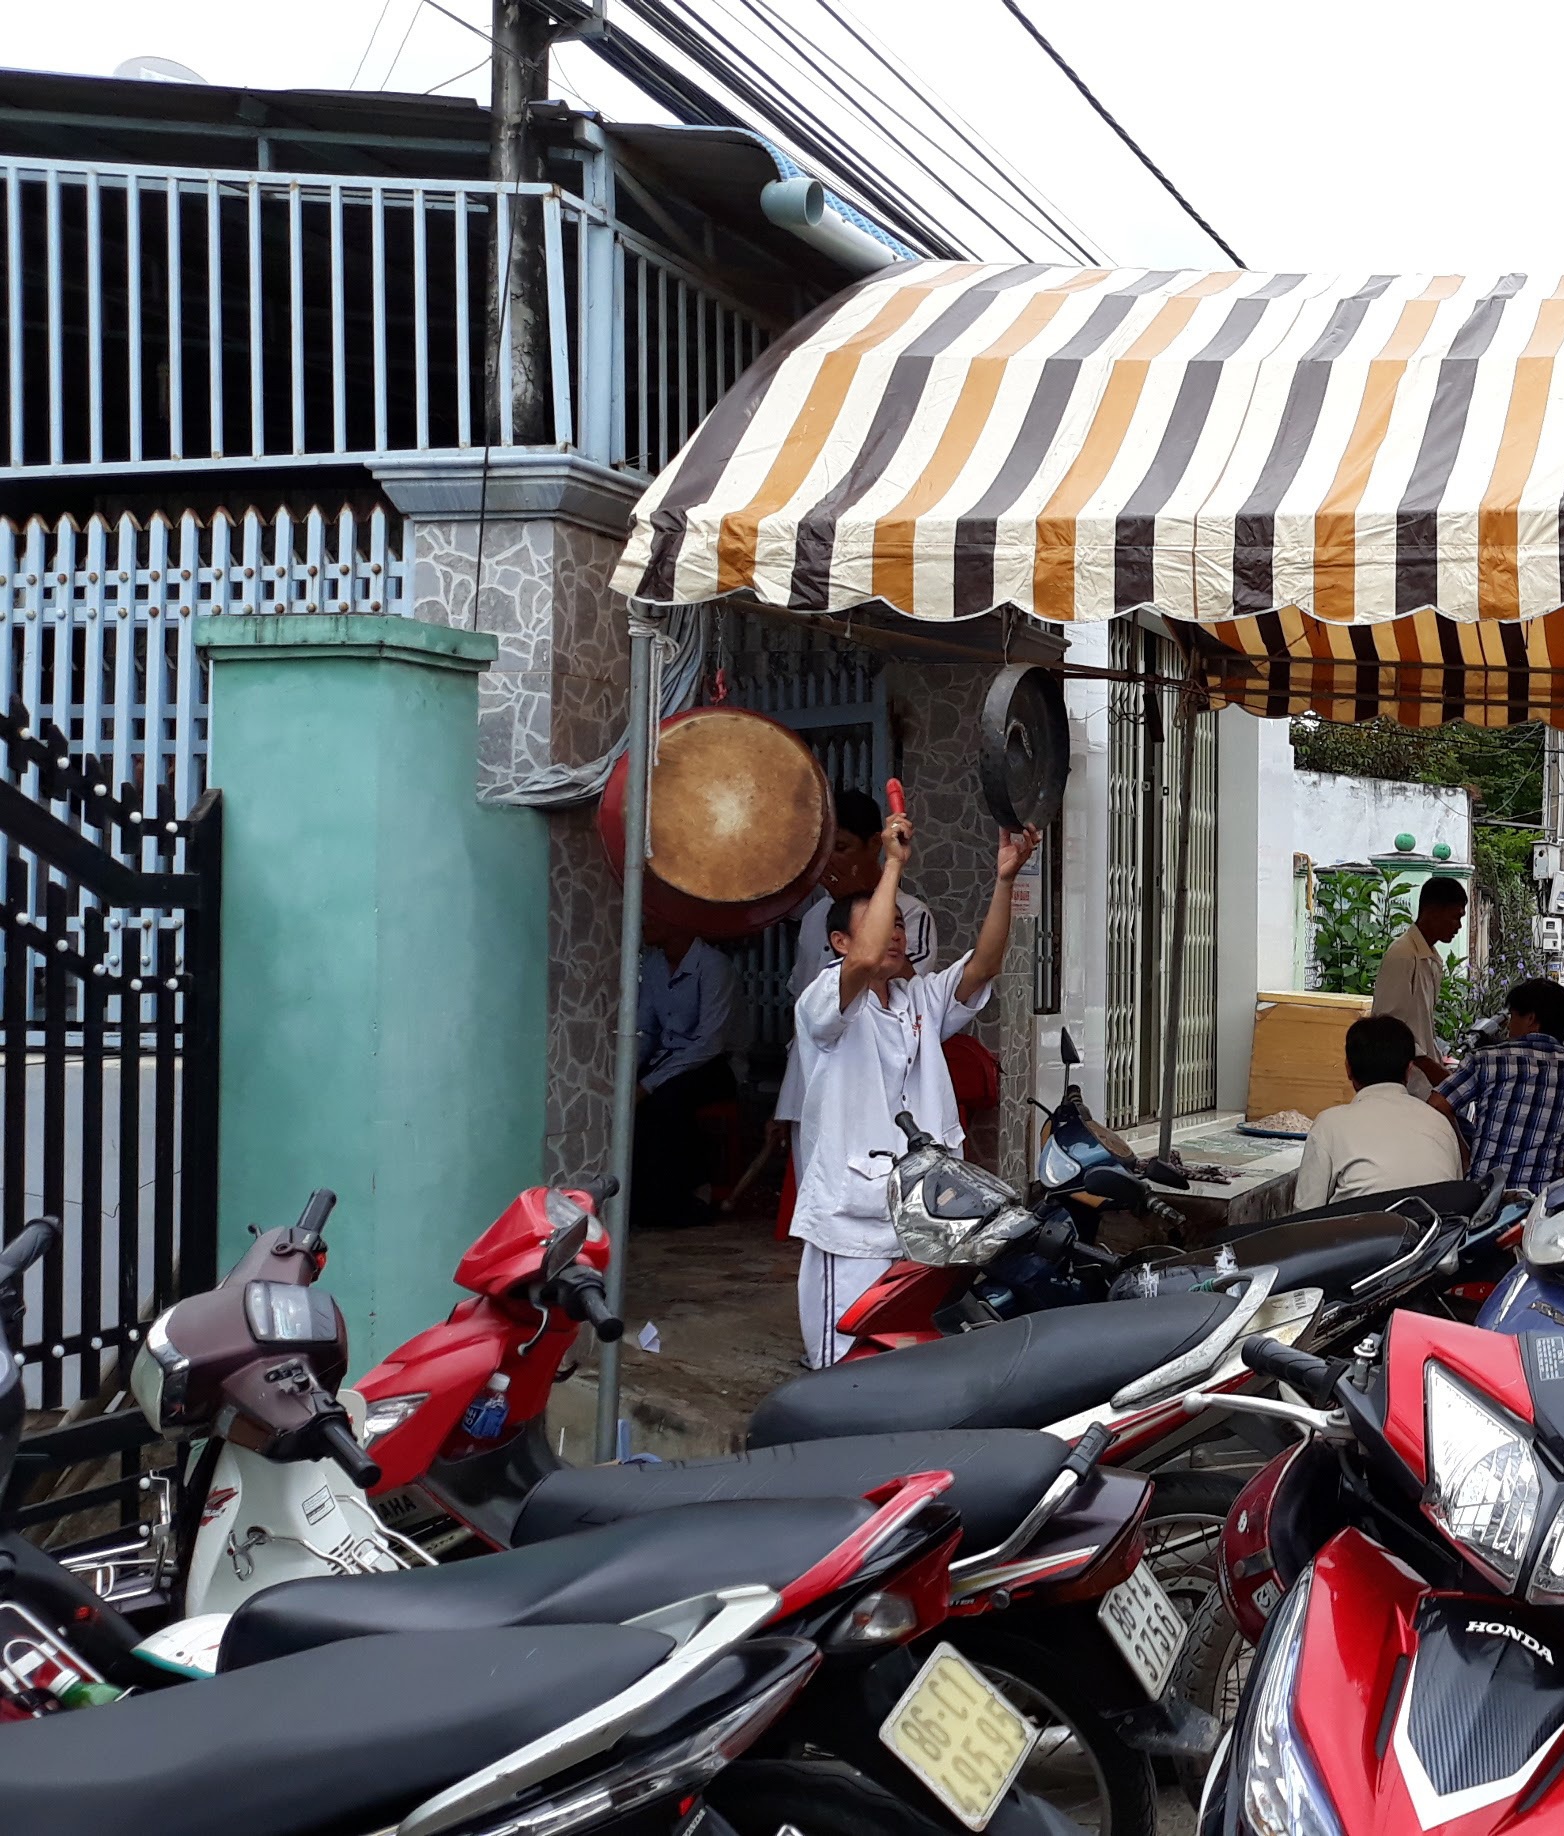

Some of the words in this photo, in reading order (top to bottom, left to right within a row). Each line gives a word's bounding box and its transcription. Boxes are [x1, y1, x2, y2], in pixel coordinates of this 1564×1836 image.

[378, 1494, 417, 1520] AHA
[1135, 1601, 1178, 1682] 3756
[1465, 1620, 1555, 1666] HONDA
